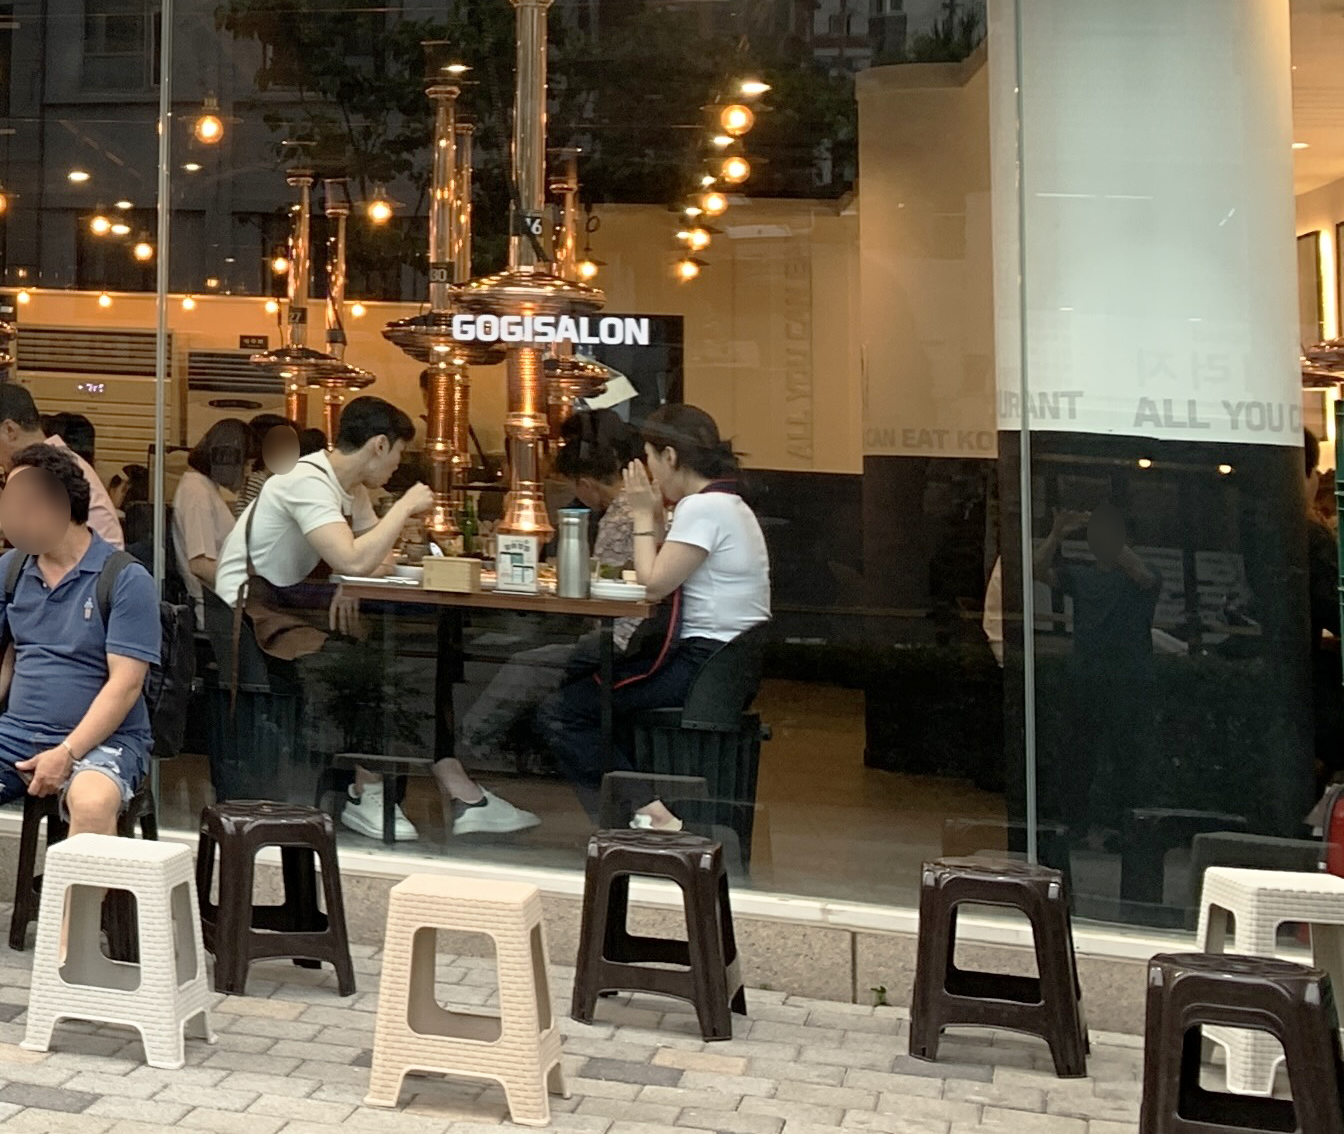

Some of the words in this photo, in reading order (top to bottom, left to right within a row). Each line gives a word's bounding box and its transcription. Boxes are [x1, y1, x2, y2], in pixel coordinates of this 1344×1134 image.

[451, 313, 650, 347] GOGISALON
[1133, 396, 1211, 429] ALL
[1222, 399, 1284, 433] YOU
